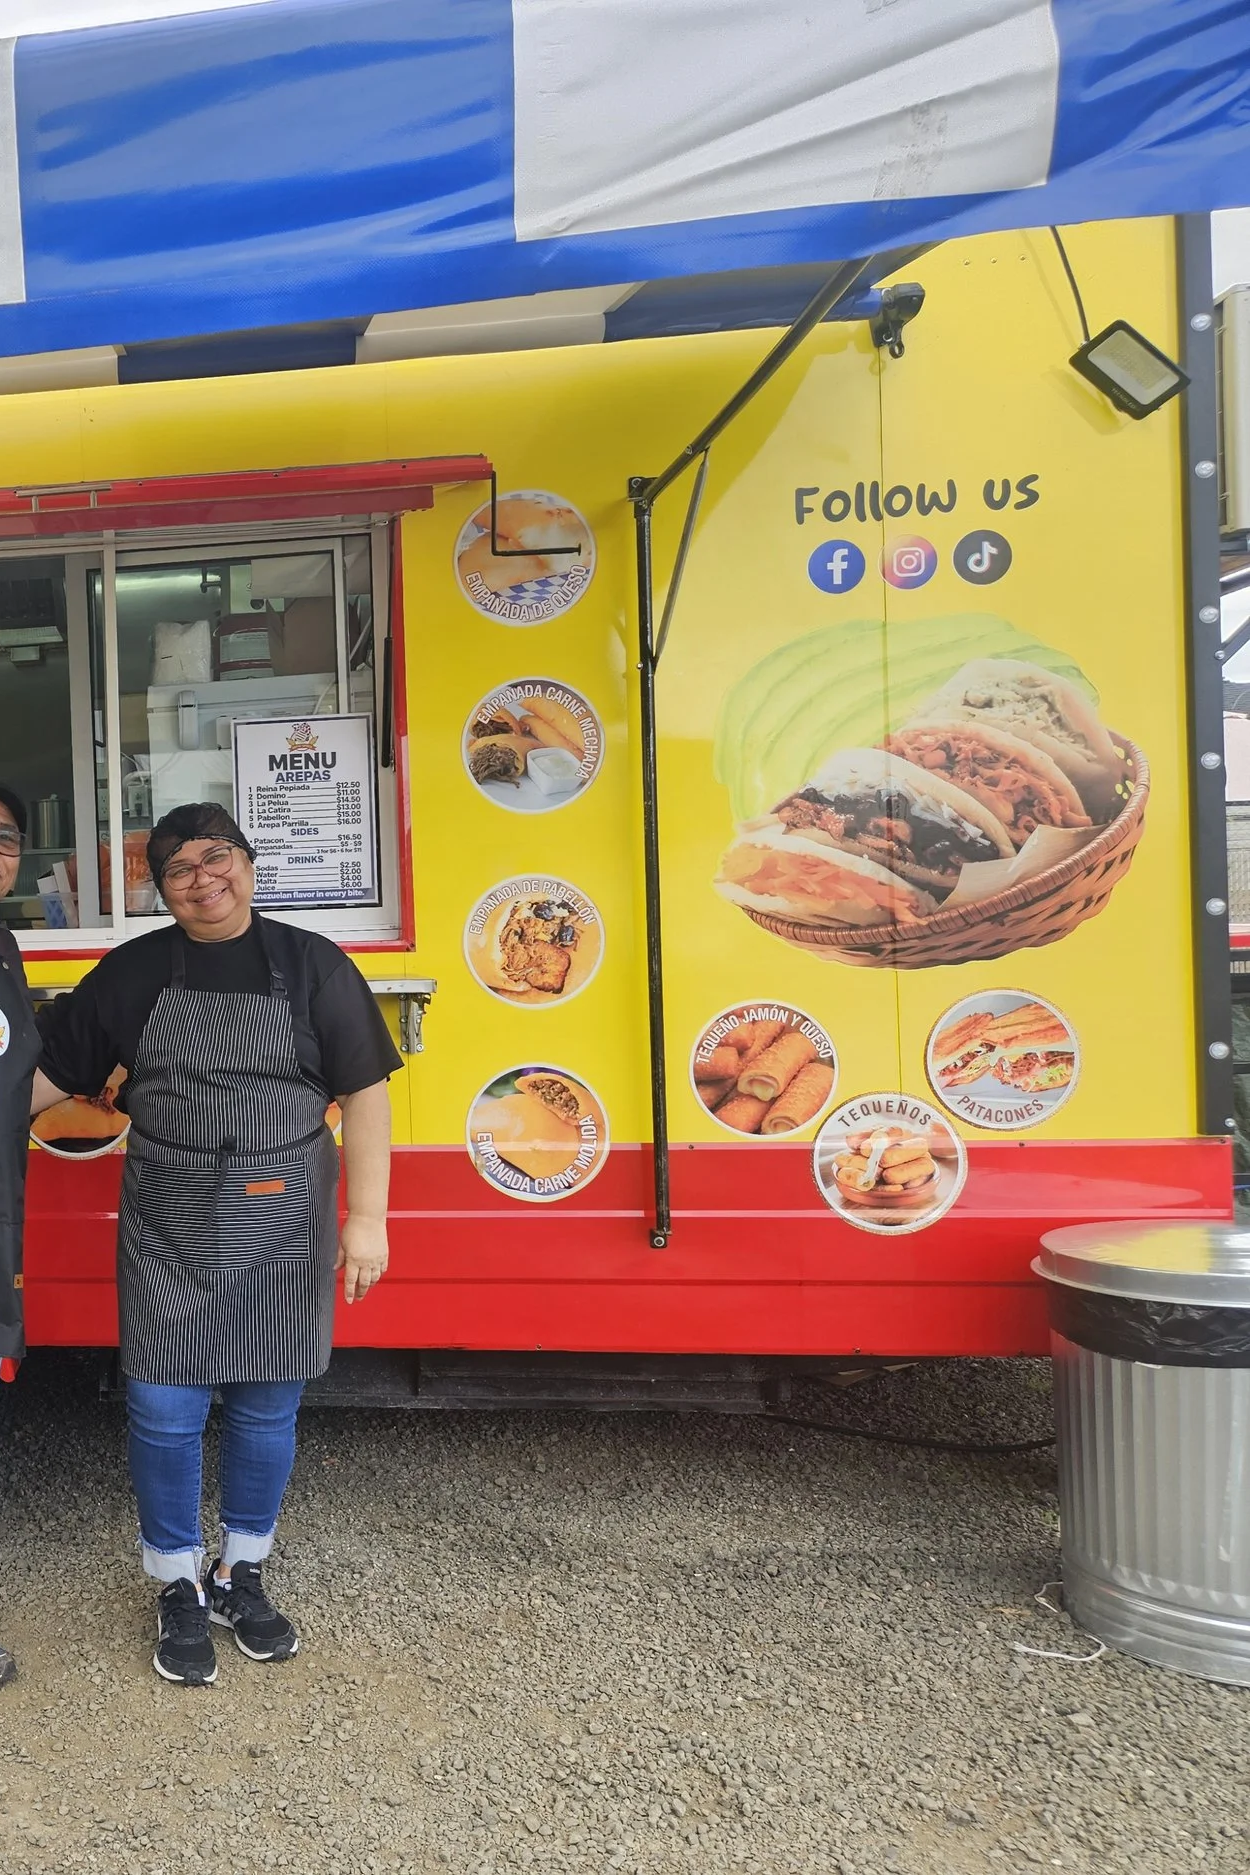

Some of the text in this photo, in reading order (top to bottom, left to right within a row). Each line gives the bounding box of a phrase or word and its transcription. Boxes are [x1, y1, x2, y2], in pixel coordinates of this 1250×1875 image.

[465, 565, 587, 621] EMPANADA DE QUESO
[476, 684, 598, 780] EMPANADA CARNE MECHADA
[268, 752, 337, 772] MENU
[276, 770, 331, 783] AREPAS
[279, 784, 310, 793] Pepiada
[336, 781, 361, 790] $12.50
[256, 792, 286, 800] Domino
[336, 789, 360, 797] $11.00
[336, 796, 361, 804] $14.50
[267, 806, 291, 814] Catira
[336, 803, 361, 811] $13.00
[337, 810, 361, 818] $15.00
[337, 818, 362, 826] $16.00
[290, 827, 319, 836] SIDES
[254, 844, 293, 852] Empanadas
[287, 855, 324, 864] DRINKS
[339, 861, 361, 869] $2.50
[340, 874, 362, 882] $4.00
[253, 892, 292, 900] enezuelan
[325, 891, 347, 899] every
[469, 880, 596, 935] EMPANADA DE PABELLÓN
[695, 1004, 833, 1064] TEQUEÑO JAMÓN Y QUESO
[837, 1099, 932, 1129] TEQUEÑOS
[957, 1095, 1045, 1124] PATACONES
[476, 1113, 598, 1194] EMPANADA CARNE MOLIDA
